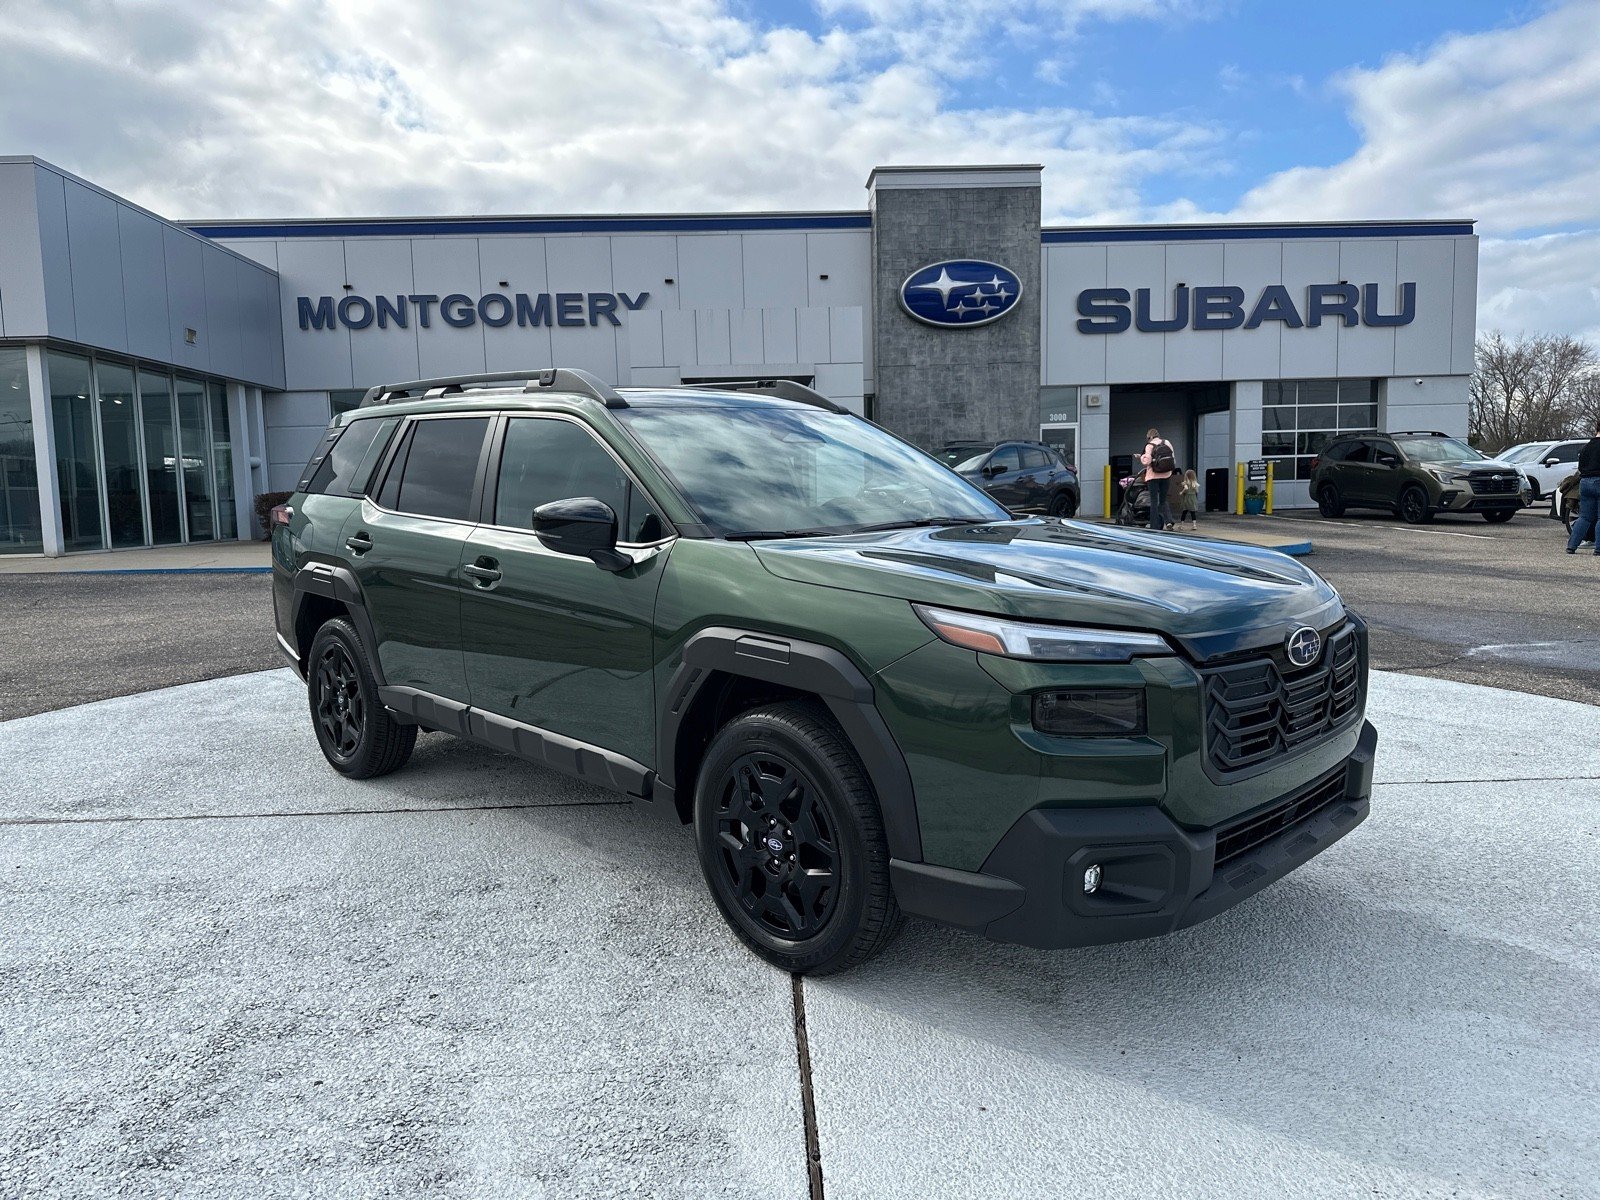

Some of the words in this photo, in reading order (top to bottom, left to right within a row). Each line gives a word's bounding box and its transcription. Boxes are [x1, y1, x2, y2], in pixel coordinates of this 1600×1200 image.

[297, 292, 650, 329] MONTGOMERY
[1077, 282, 1416, 334] SUBARU
[1049, 413, 1067, 421] 3000
